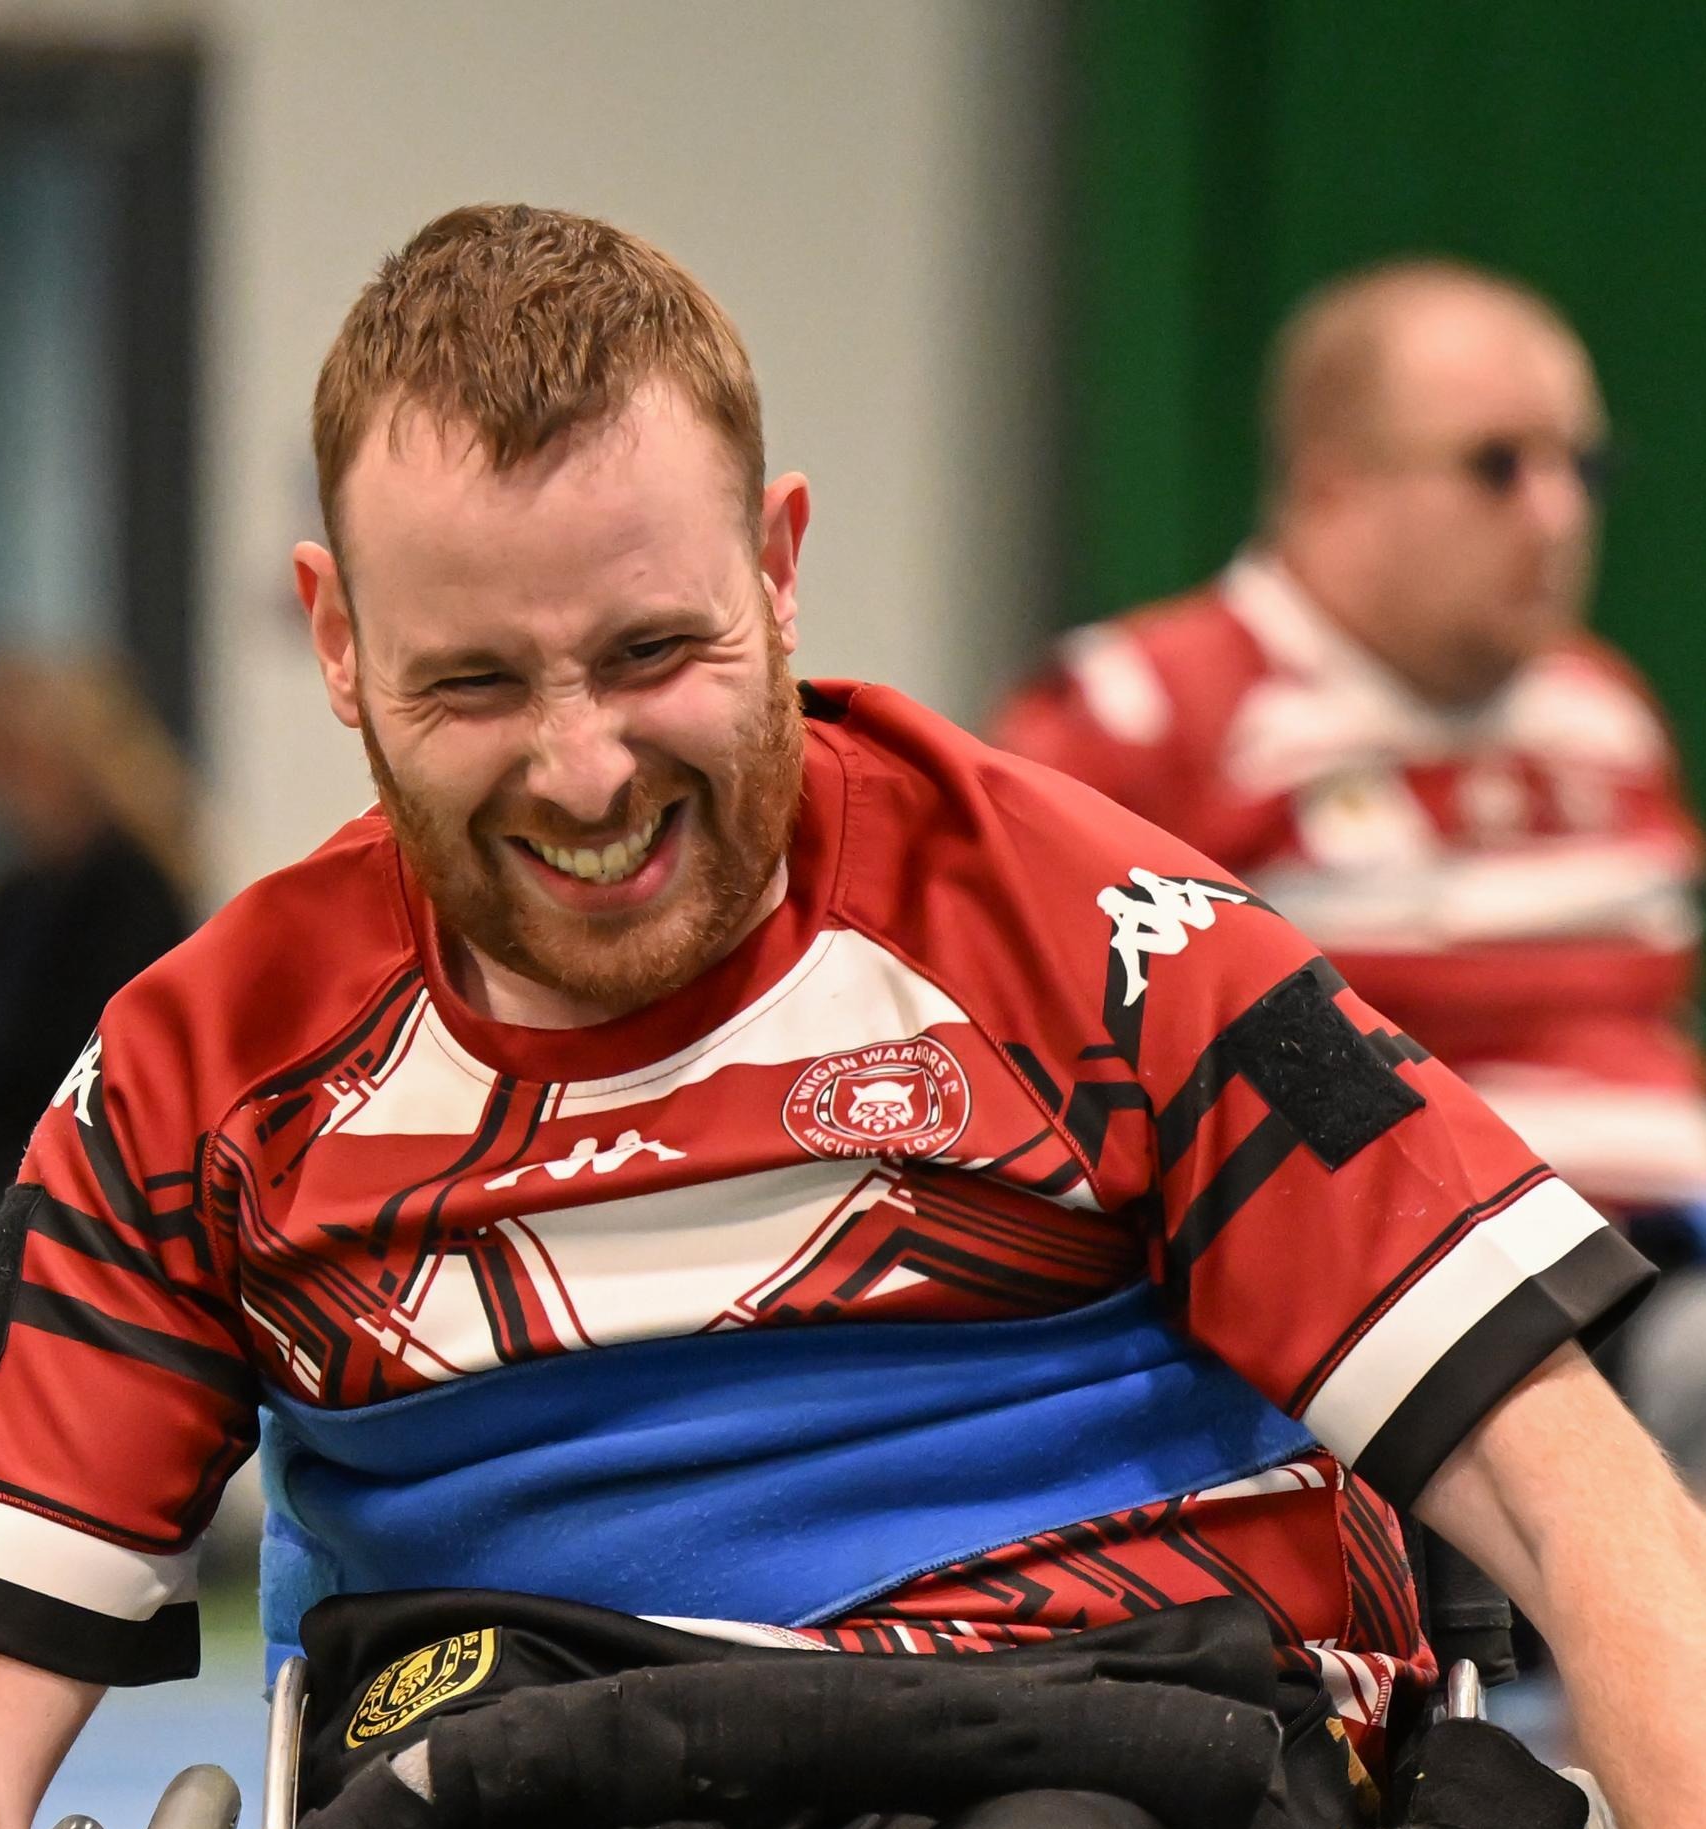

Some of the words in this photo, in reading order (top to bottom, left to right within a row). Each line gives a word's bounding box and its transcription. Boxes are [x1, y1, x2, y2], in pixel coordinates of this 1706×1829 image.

[796, 1056, 859, 1101] WIGAN
[862, 1044, 950, 1078] WARRIORS
[941, 1080, 961, 1097] 72
[792, 1105, 808, 1114] 18
[803, 1127, 878, 1158] ANCIENT
[903, 1126, 955, 1155] LOYAL
[462, 1650, 479, 1660] 72
[412, 1680, 460, 1709] LOYAL
